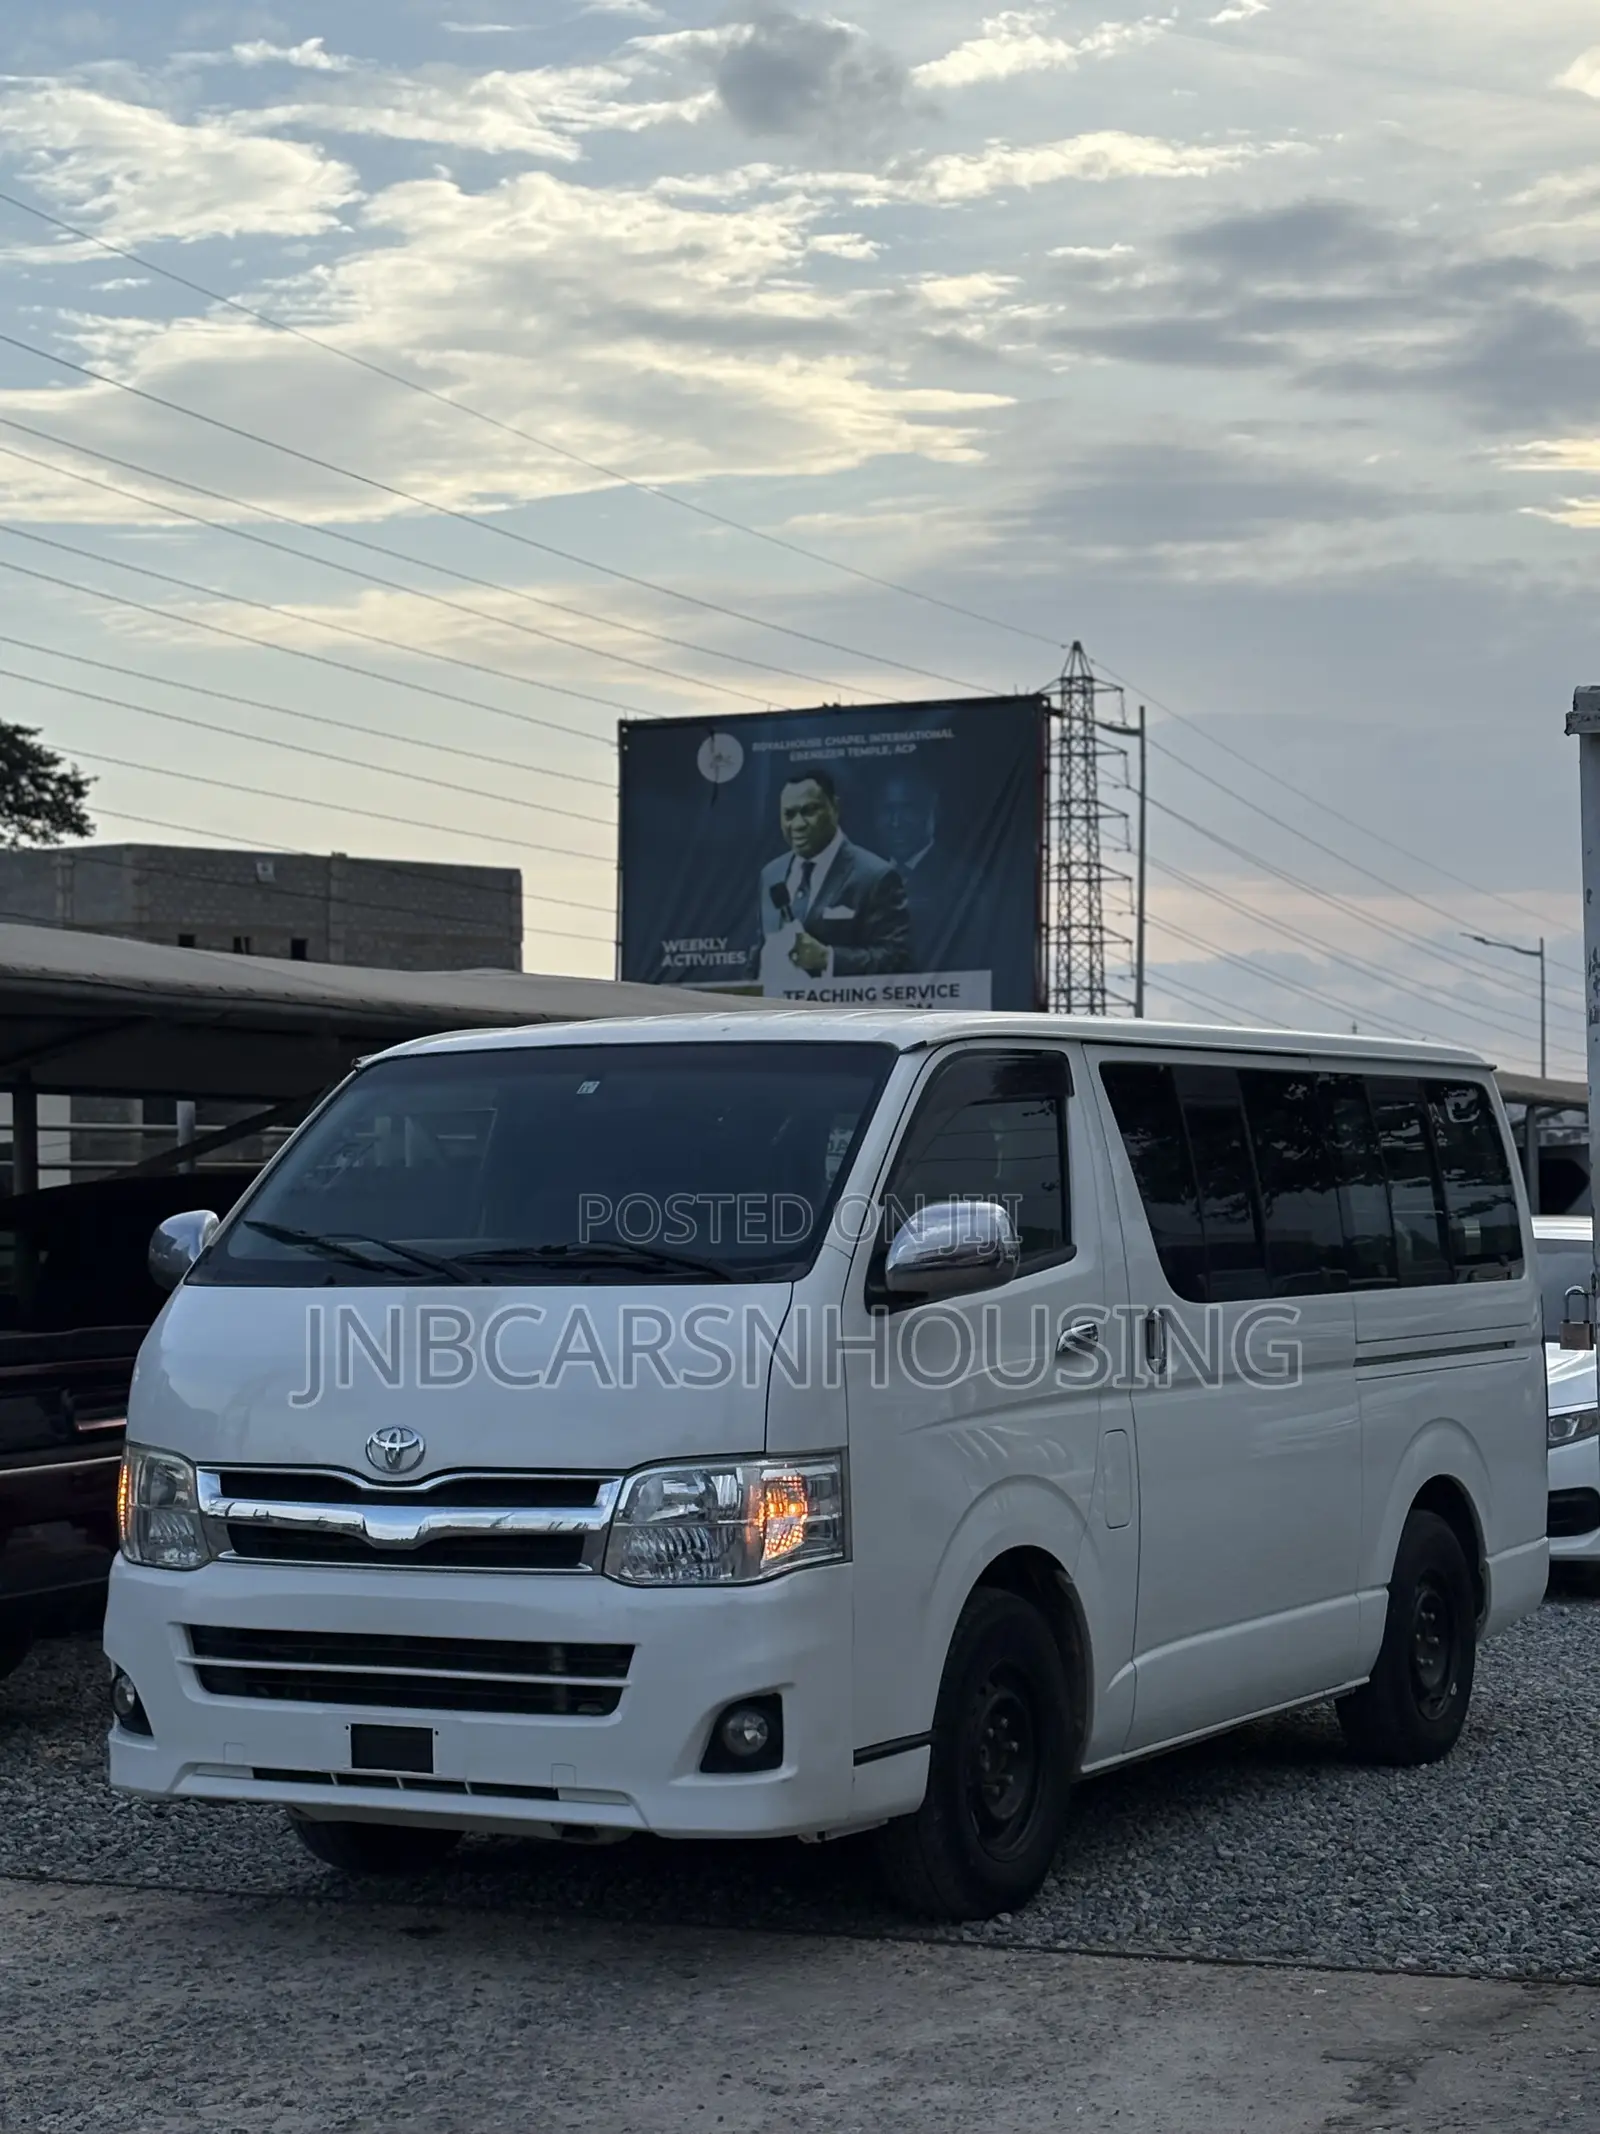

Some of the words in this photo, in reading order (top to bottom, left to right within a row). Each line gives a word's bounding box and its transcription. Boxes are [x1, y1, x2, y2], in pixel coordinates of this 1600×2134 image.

[752, 738, 822, 752] ROYALHOUSE
[825, 734, 867, 747] CHAPEL
[869, 728, 955, 744] INTERNATIONAL
[848, 745, 892, 758] TEMPLE,
[894, 743, 918, 755] ACP
[662, 937, 728, 953] WEEKLY
[661, 951, 748, 967] ACTIVITIES
[782, 986, 878, 1003] TEACHING
[881, 983, 960, 1001] SERVICE
